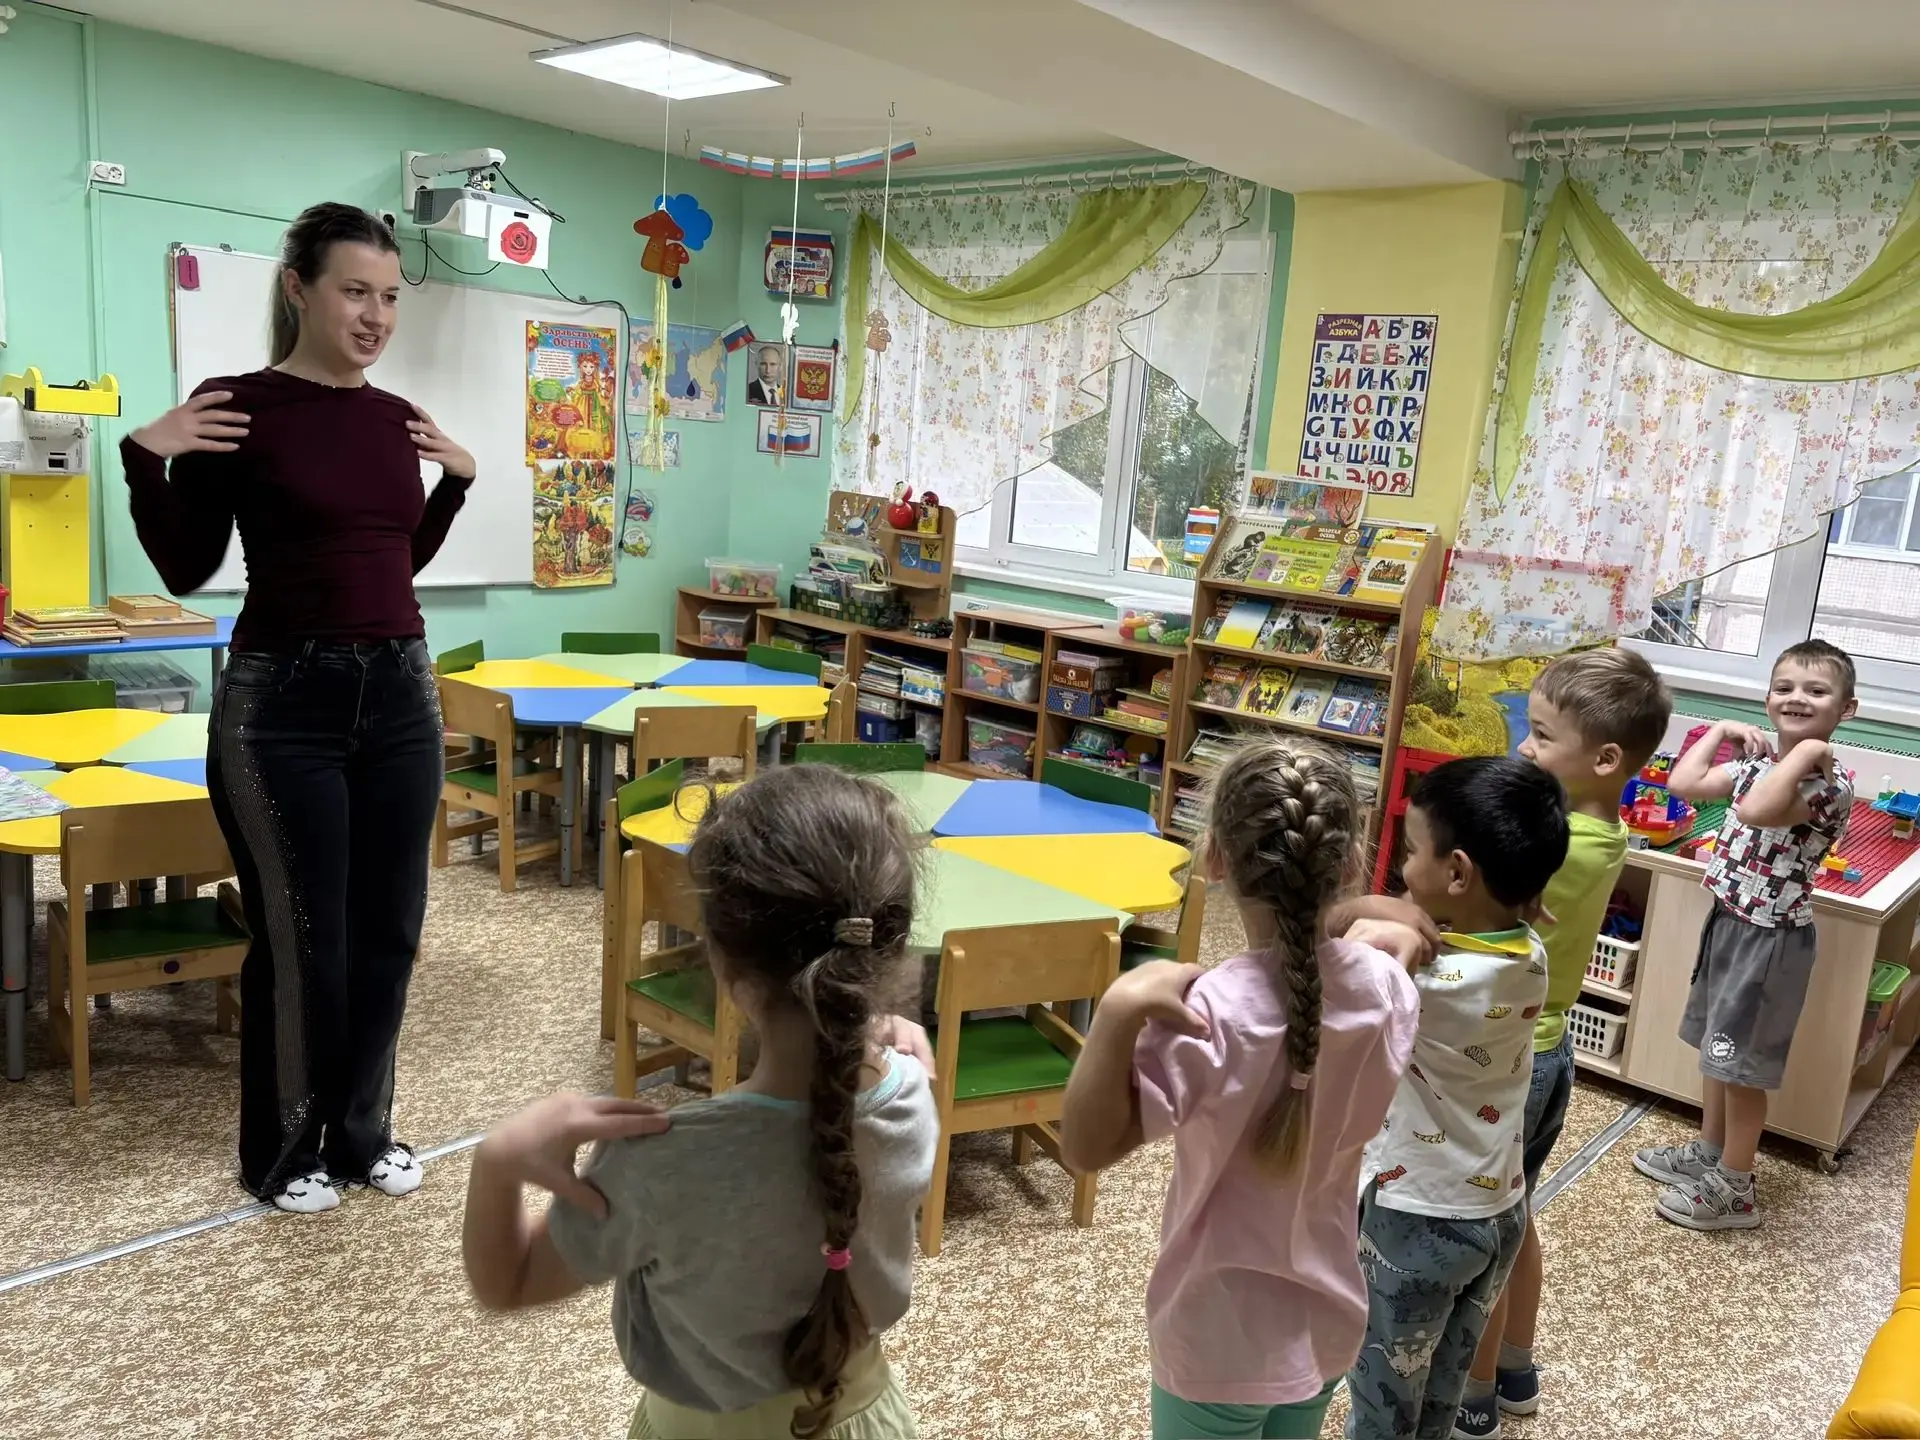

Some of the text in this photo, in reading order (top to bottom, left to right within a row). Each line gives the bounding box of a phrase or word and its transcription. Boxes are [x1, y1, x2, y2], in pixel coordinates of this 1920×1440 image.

[1328, 318, 1362, 330] РАЗРЕЗНАЯ
[1387, 320, 1402, 339] Б
[1315, 343, 1330, 363] Г
[1336, 344, 1356, 364] Д
[1383, 343, 1400, 365] Ё
[1407, 345, 1430, 366] Ж
[1312, 367, 1427, 392] З И Й К Л
[1308, 393, 1327, 413] М
[1331, 393, 1349, 414] Н
[1376, 396, 1393, 416] П
[1373, 418, 1395, 441] Ф
[1302, 440, 1414, 469] Ц Ч Ш Щ Ъ
[1367, 470, 1388, 492] Ю
[1389, 472, 1408, 492] Я
